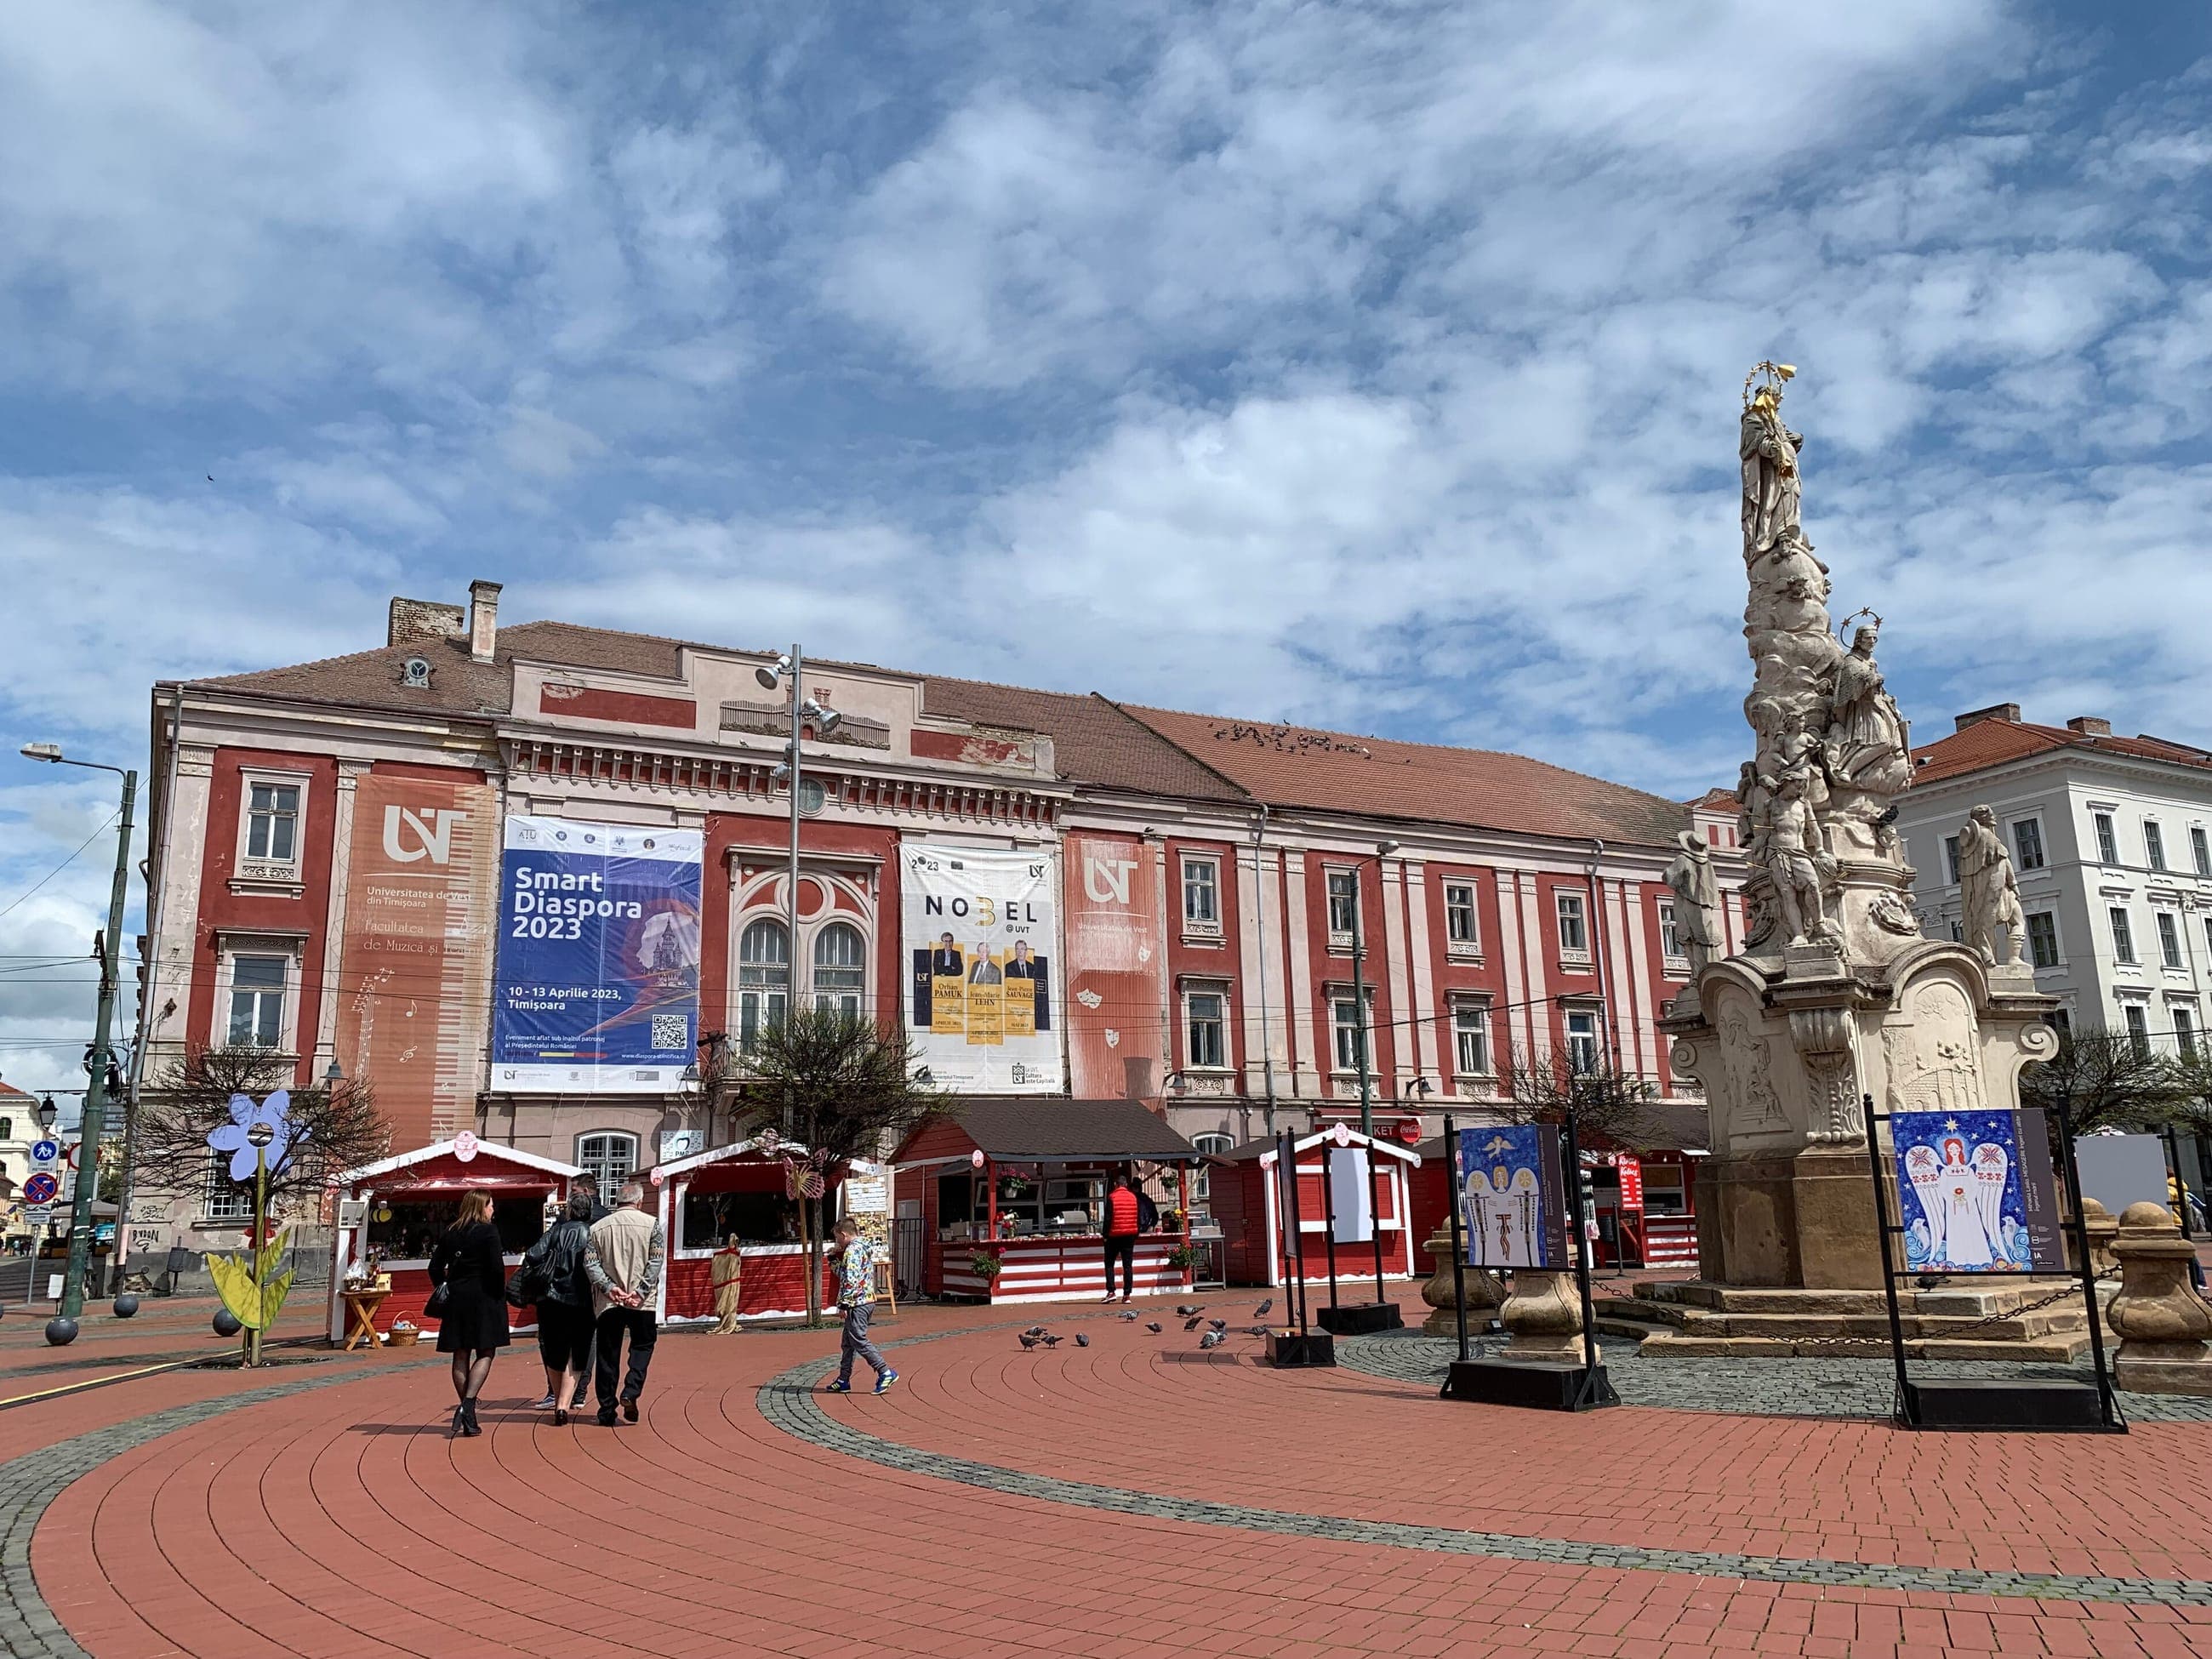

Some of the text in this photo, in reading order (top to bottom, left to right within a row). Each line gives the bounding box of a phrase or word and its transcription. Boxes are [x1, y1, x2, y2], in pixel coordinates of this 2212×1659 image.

[515, 866, 603, 892] Smart
[367, 886, 434, 899] Universitatea
[436, 890, 449, 900] de
[367, 896, 382, 905] din
[514, 890, 642, 921] Diaspora
[365, 919, 424, 933] Facultatea
[512, 915, 581, 940] 2023
[1015, 926, 1030, 934] UVT
[363, 938, 381, 951] de
[509, 986, 523, 997] 10
[532, 987, 545, 997] 13
[549, 987, 589, 1000] Aprilie
[591, 989, 622, 1001] 2023,
[934, 989, 963, 998] PAMUK
[1006, 990, 1034, 999] SAUVAGE
[508, 999, 566, 1012] Timișoara
[1350, 1125, 1394, 1136] MKET
